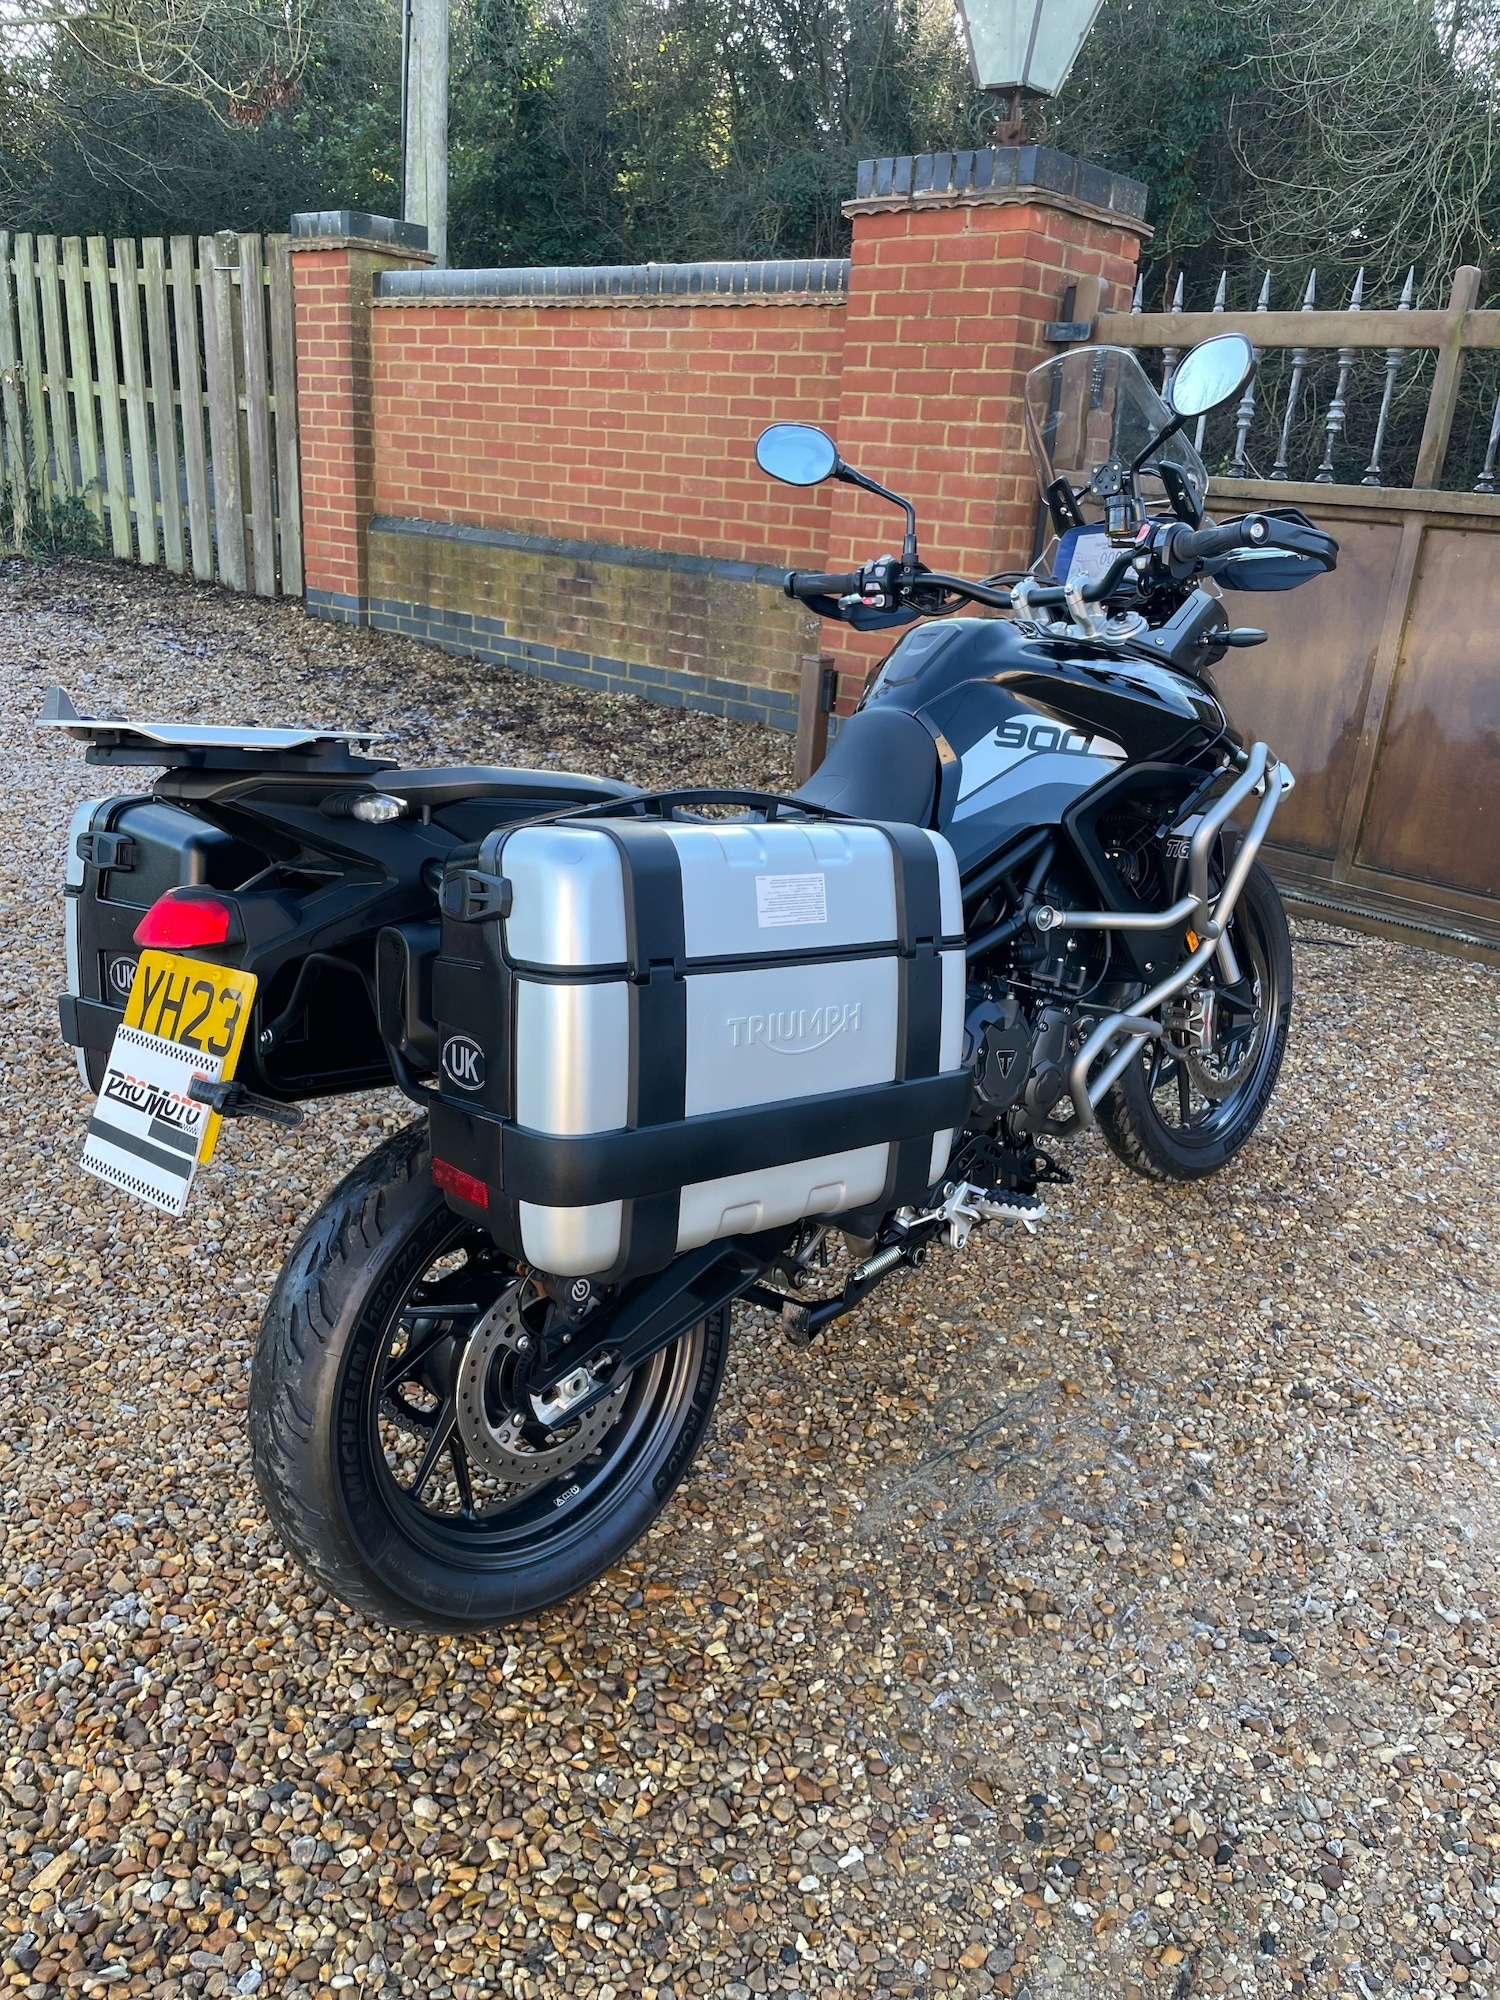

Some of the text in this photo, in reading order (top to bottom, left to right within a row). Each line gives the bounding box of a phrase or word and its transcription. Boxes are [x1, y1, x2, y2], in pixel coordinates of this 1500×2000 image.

[994, 722, 1091, 753] 900
[1166, 839, 1191, 859] TIG
[116, 966, 135, 990] UK
[138, 966, 242, 1057] YH23
[728, 1003, 861, 1054] TRIUMPH
[452, 1043, 480, 1083] UK
[1261, 1029, 1285, 1098] MICHELIN
[369, 1241, 420, 1322] 150/70
[699, 1310, 722, 1398] HELIN
[341, 1343, 368, 1500] MICHELIN
[668, 1412, 700, 1473] ROAD
